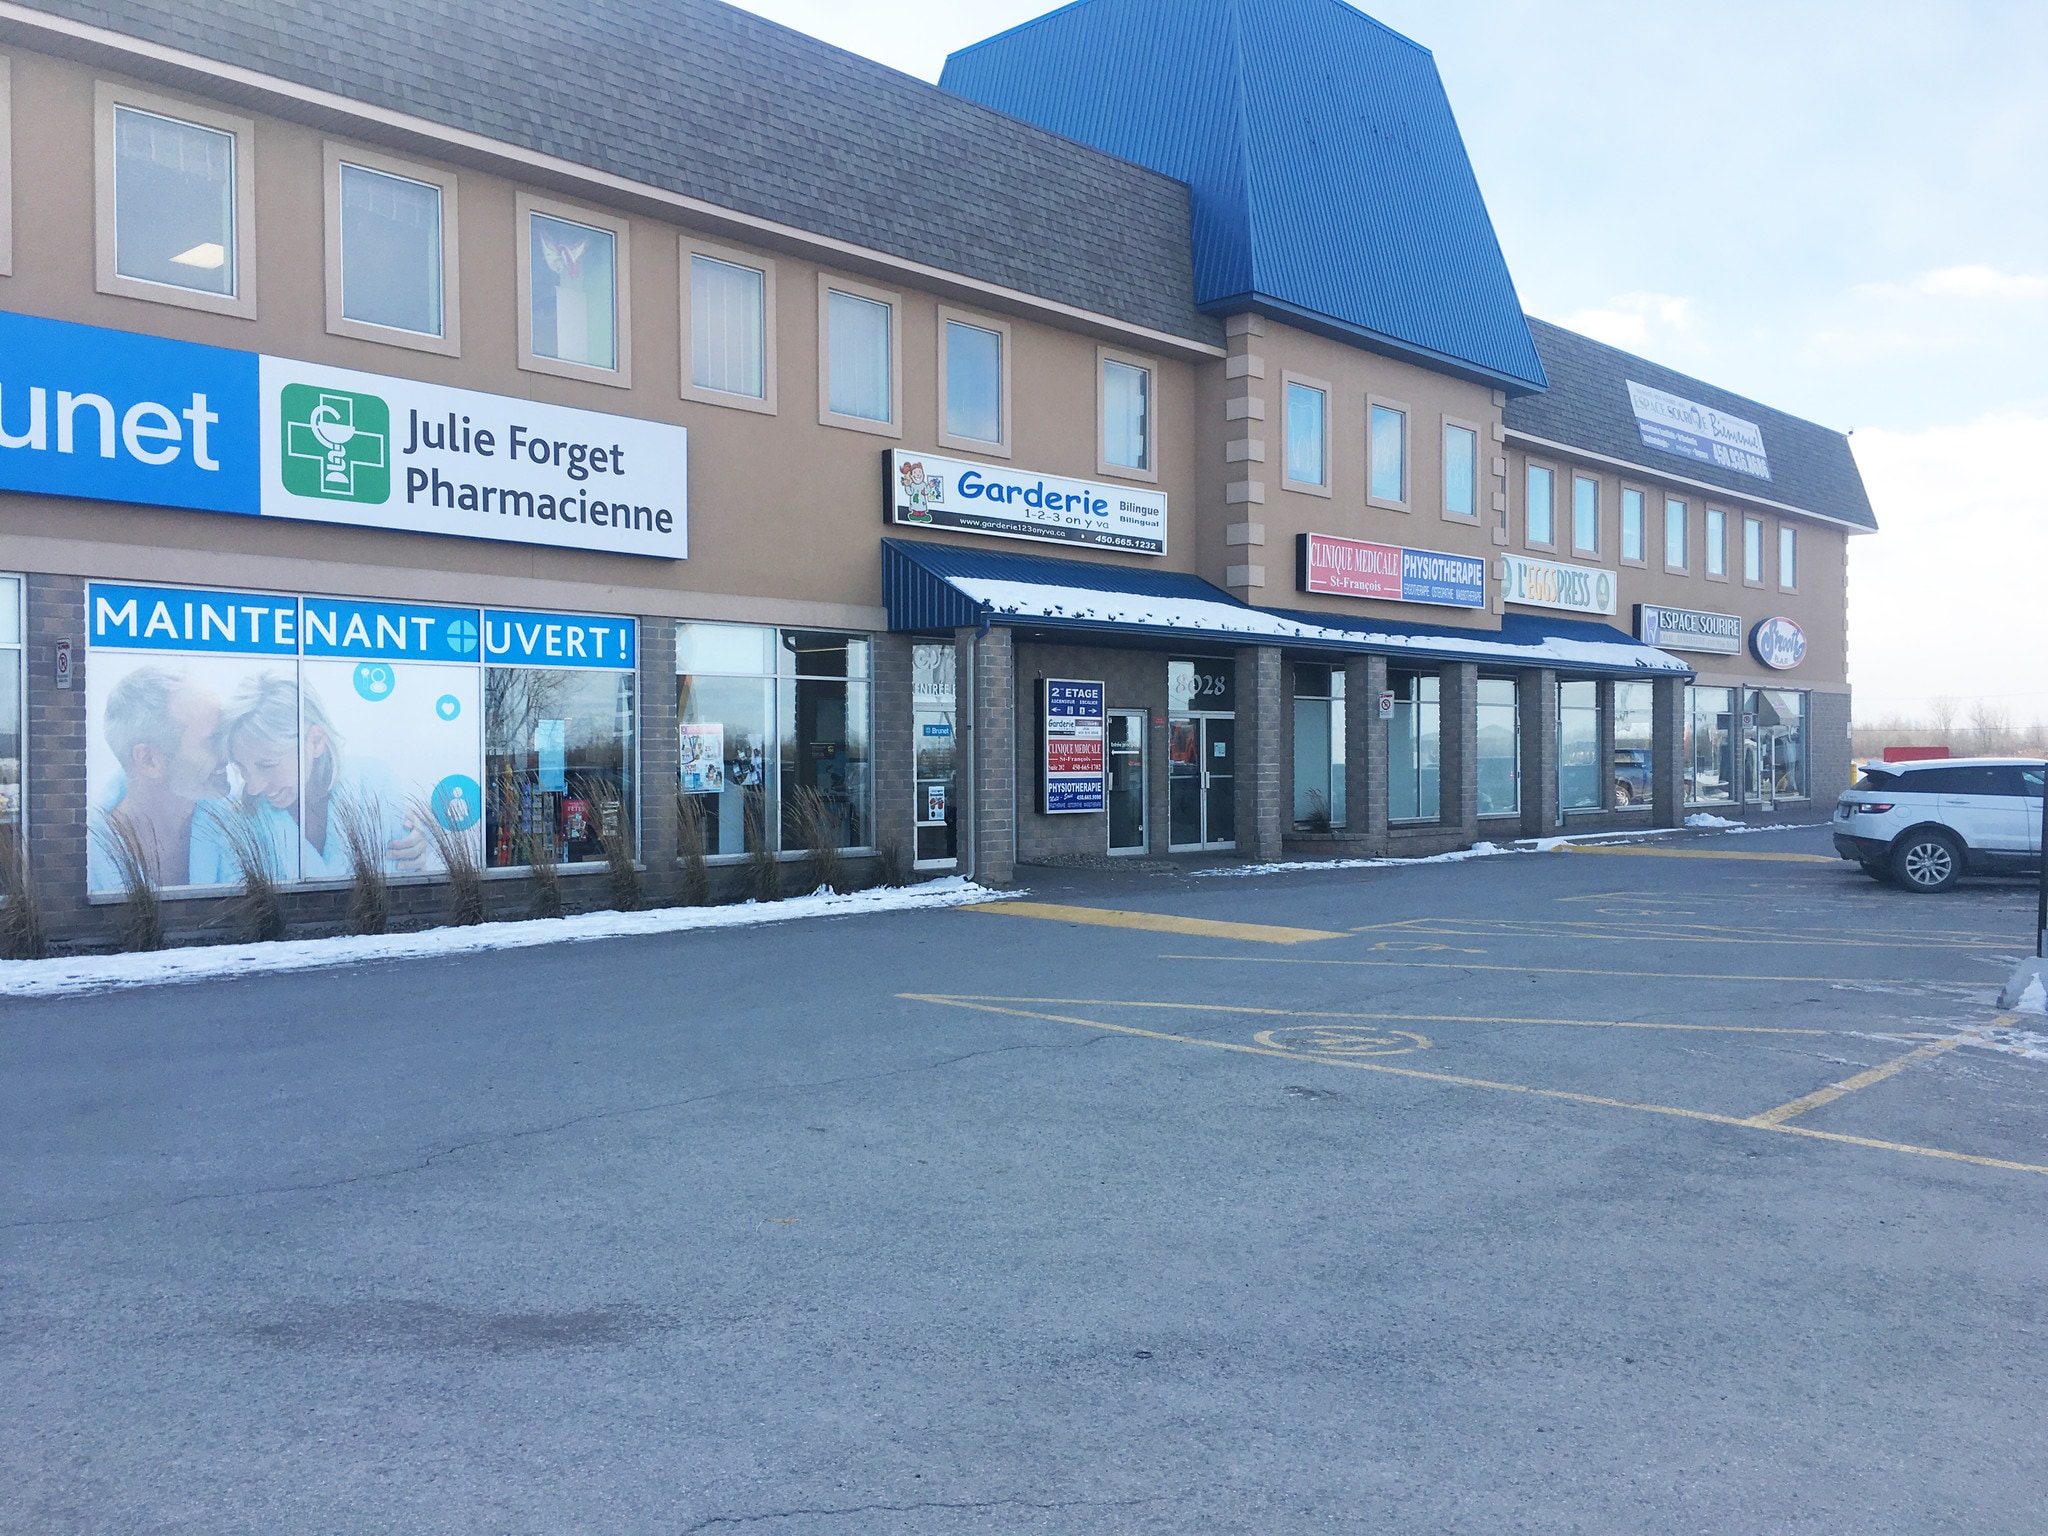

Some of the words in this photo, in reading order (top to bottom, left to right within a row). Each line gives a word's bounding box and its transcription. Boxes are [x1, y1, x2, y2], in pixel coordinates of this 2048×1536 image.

[403, 409, 496, 457] Julie
[510, 425, 625, 481] Forget
[406, 467, 673, 533] Pharmacienne
[958, 470, 1109, 518] Garderie
[1025, 508, 1061, 523] 1-2-3
[1065, 516, 1081, 526] on
[1084, 518, 1093, 529] y
[1096, 520, 1110, 529] va
[1119, 500, 1160, 517] Bilingue
[1119, 515, 1160, 528] Bilingual
[959, 518, 1067, 538] www.garderie123onyva.ca
[1095, 534, 1156, 550] 450.665.1232
[1311, 542, 1353, 575] CLINIQUE
[1354, 548, 1398, 576] MEDICALE
[1403, 554, 1483, 586] PHYSIOTHERAPIE
[1330, 575, 1382, 593] St-François
[1517, 562, 1591, 607] L'EGGSPRESS
[96, 597, 436, 651] MAINTENANT
[1659, 610, 1698, 632] ESPACE
[1700, 615, 1740, 636] SOURIRE
[1065, 688, 1099, 699] ETAGE
[1175, 674, 1226, 696] 8028
[931, 727, 950, 735] Brunet
[1048, 718, 1075, 728] Garderie
[1048, 743, 1074, 757] CLINIQUE
[1074, 743, 1101, 754] MEDICALE
[1048, 782, 1102, 793] PHYSIOTHERAPIE
